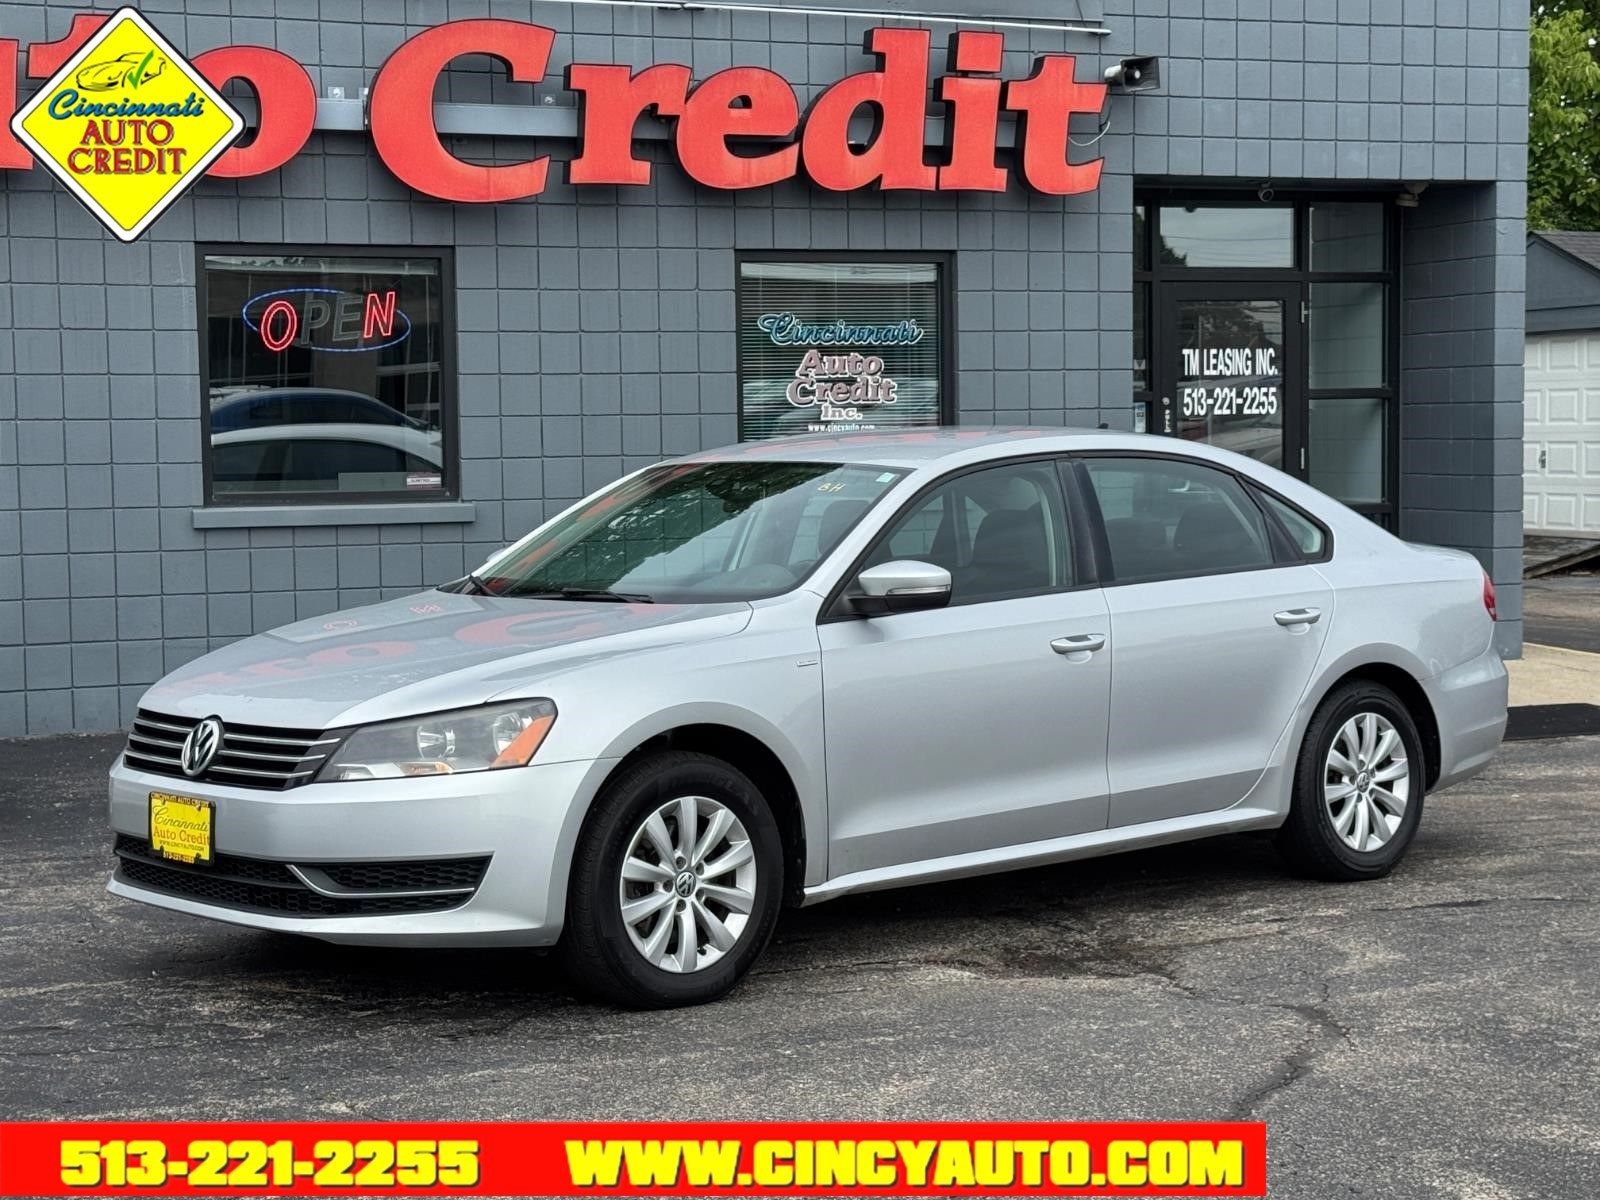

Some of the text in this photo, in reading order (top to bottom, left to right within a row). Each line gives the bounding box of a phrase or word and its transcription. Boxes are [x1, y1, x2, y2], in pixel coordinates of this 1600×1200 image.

[368, 18, 1108, 203] Credit
[261, 291, 396, 351] OPEN
[757, 312, 924, 345] Cincinnati
[796, 350, 884, 378] Auto
[1182, 347, 1278, 376] TM LEASING INC.
[786, 376, 898, 407] Credit
[1183, 386, 1278, 416] 513-221-2255
[821, 404, 863, 420] Inc.
[154, 825, 176, 841] Auto
